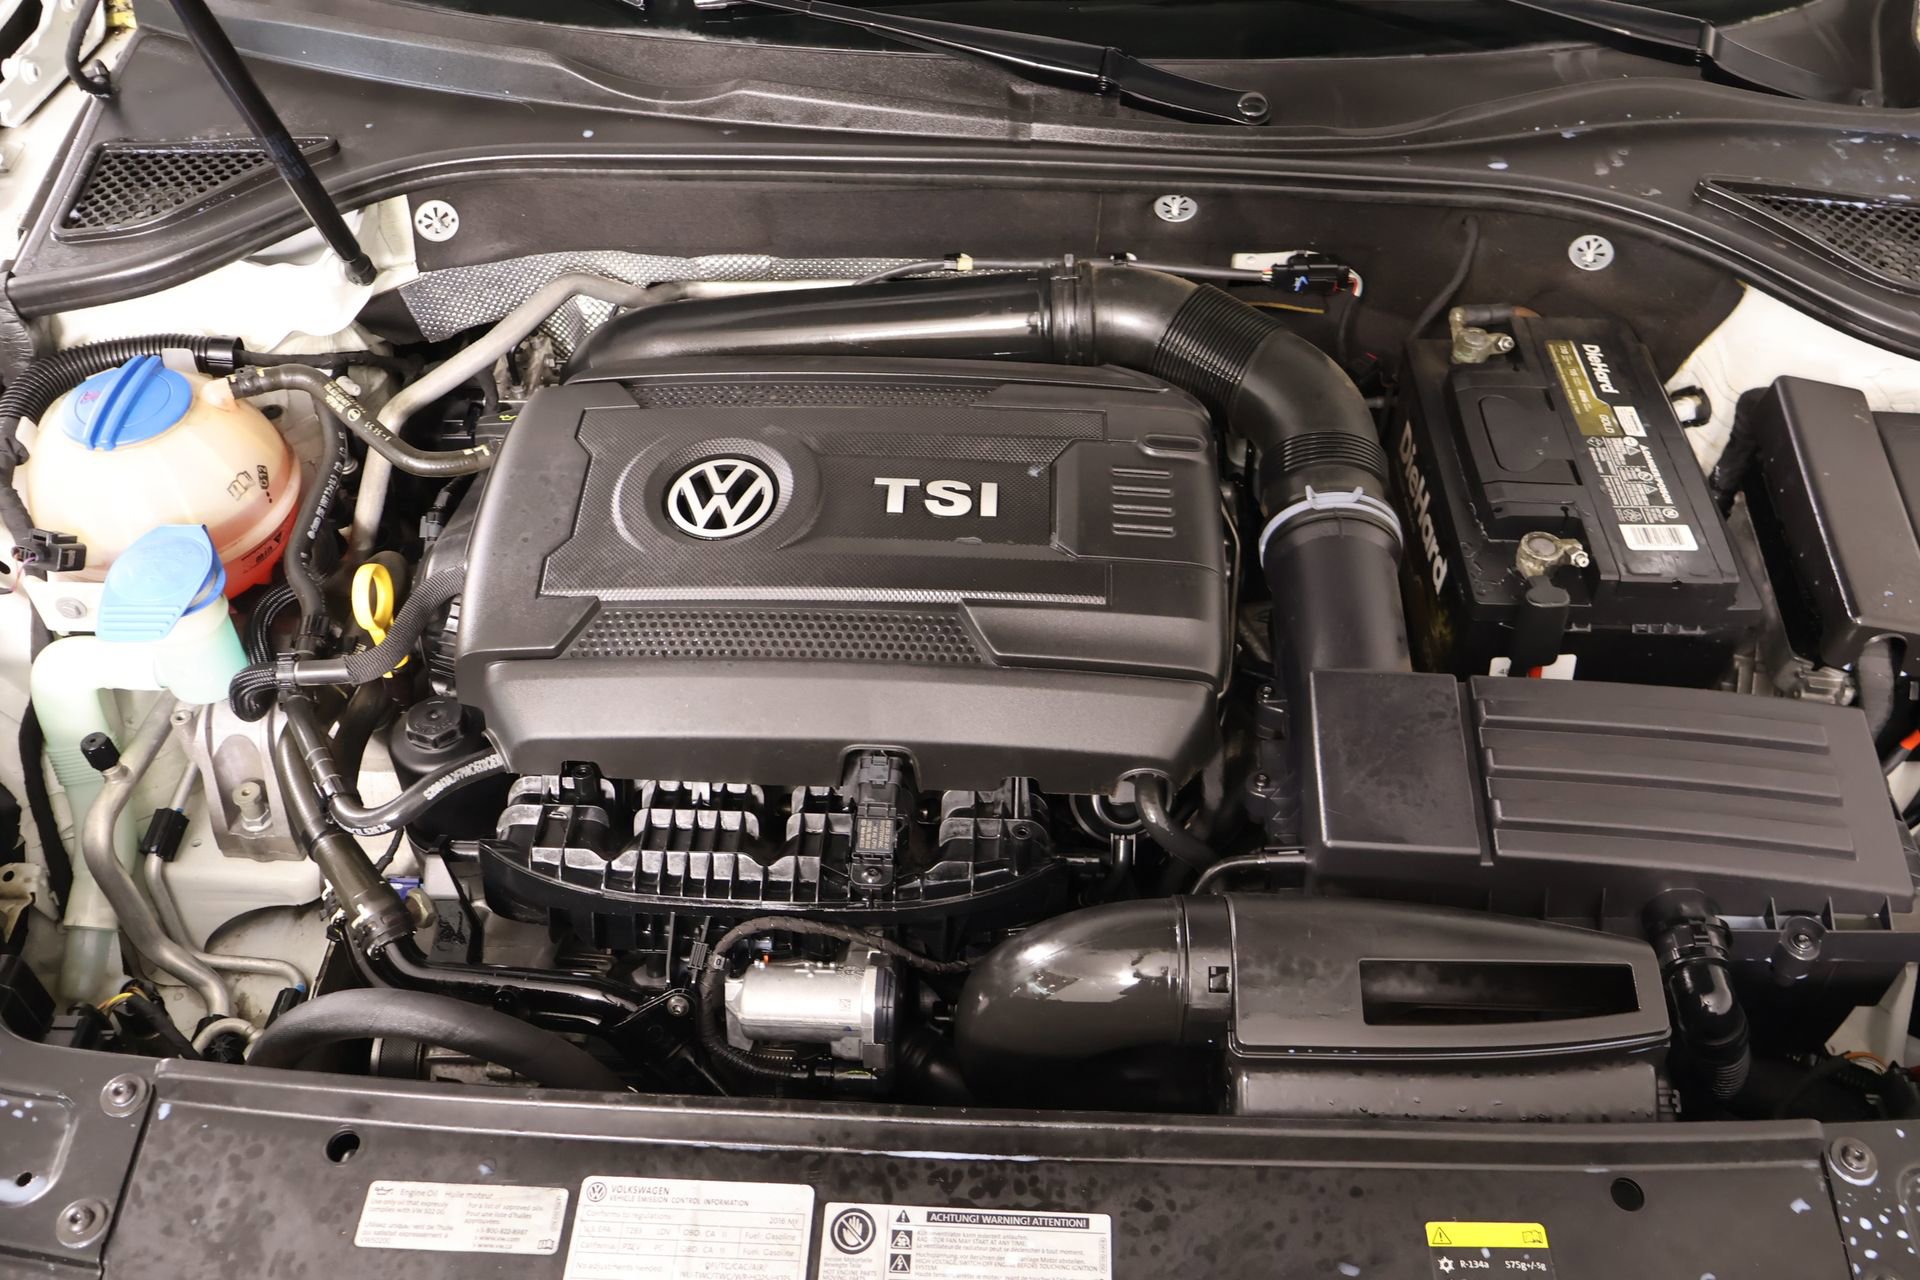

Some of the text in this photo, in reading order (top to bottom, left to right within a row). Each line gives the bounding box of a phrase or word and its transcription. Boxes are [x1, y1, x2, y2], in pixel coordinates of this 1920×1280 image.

[1582, 344, 1620, 394] DieHard
[1599, 414, 1616, 434] GOLD
[874, 477, 998, 517] TSI
[1400, 420, 1448, 596] DieHard
[400, 1188, 425, 1198] Engine
[611, 1185, 670, 1196] VOLKSWAGEN
[637, 1196, 669, 1204] EMISSION
[671, 1197, 701, 1205] CONTROL
[703, 1198, 749, 1207] INFORMATION
[930, 1213, 1087, 1228] ACHTUNG! WARNING! ATTENTION!
[1459, 1259, 1547, 1272] R-134a 575g+/-5g
